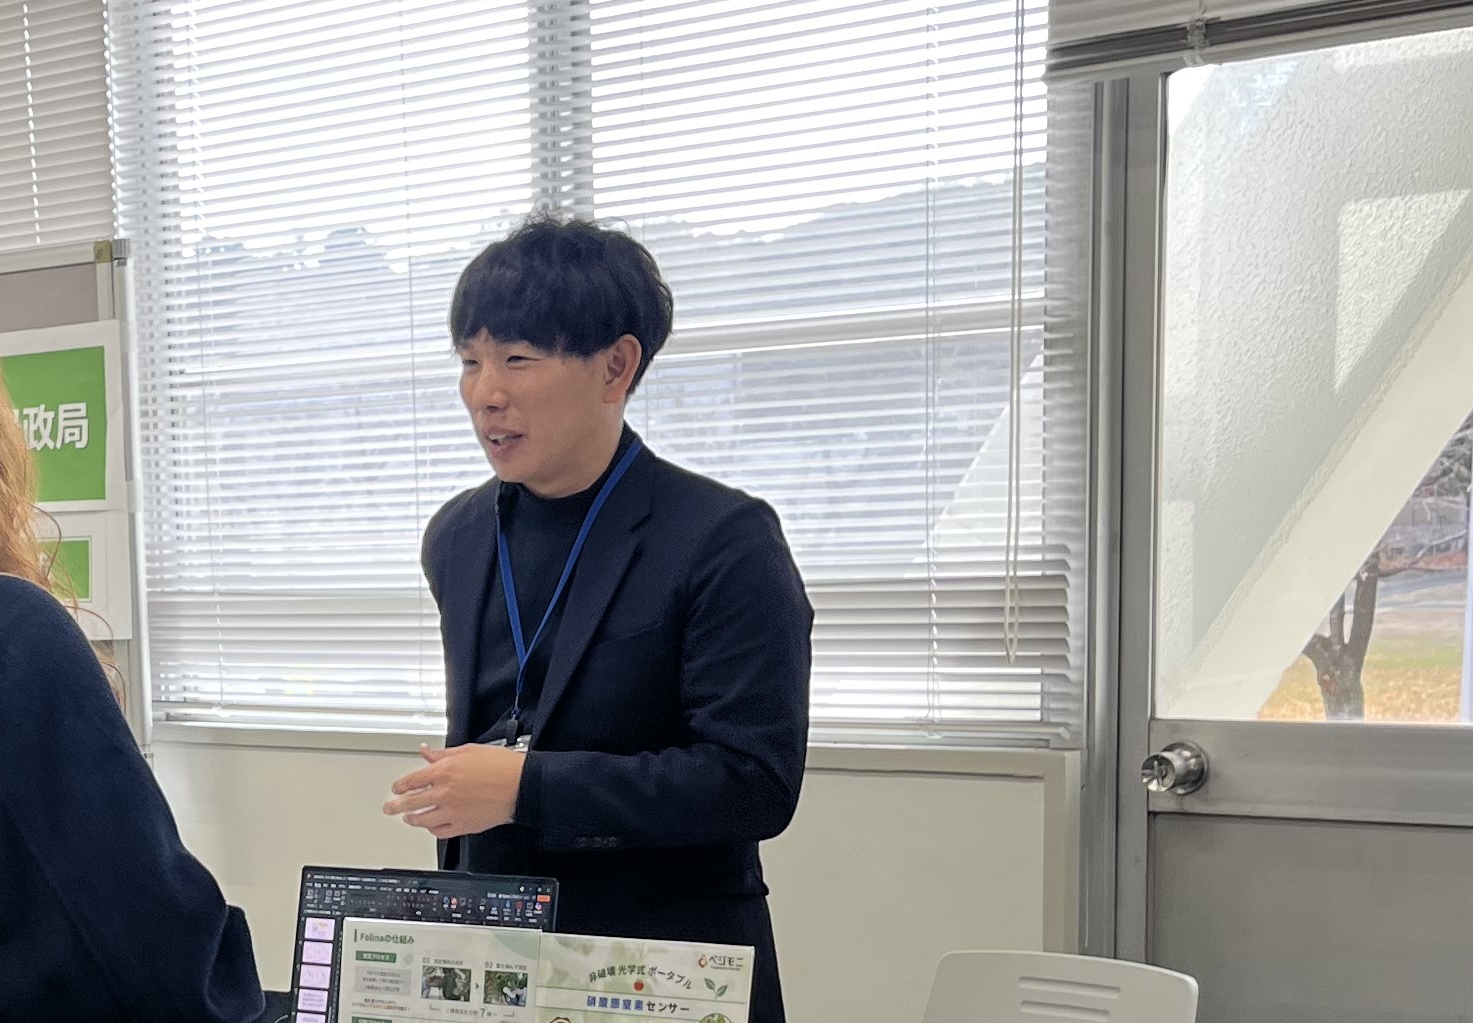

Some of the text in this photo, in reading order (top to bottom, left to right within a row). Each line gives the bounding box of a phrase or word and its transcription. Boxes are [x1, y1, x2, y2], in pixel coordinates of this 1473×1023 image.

[12, 402, 89, 450] 政局
[360, 933, 414, 944] Folinaの仕組み
[618, 964, 646, 976] 光学式
[648, 966, 692, 990] ポータブル
